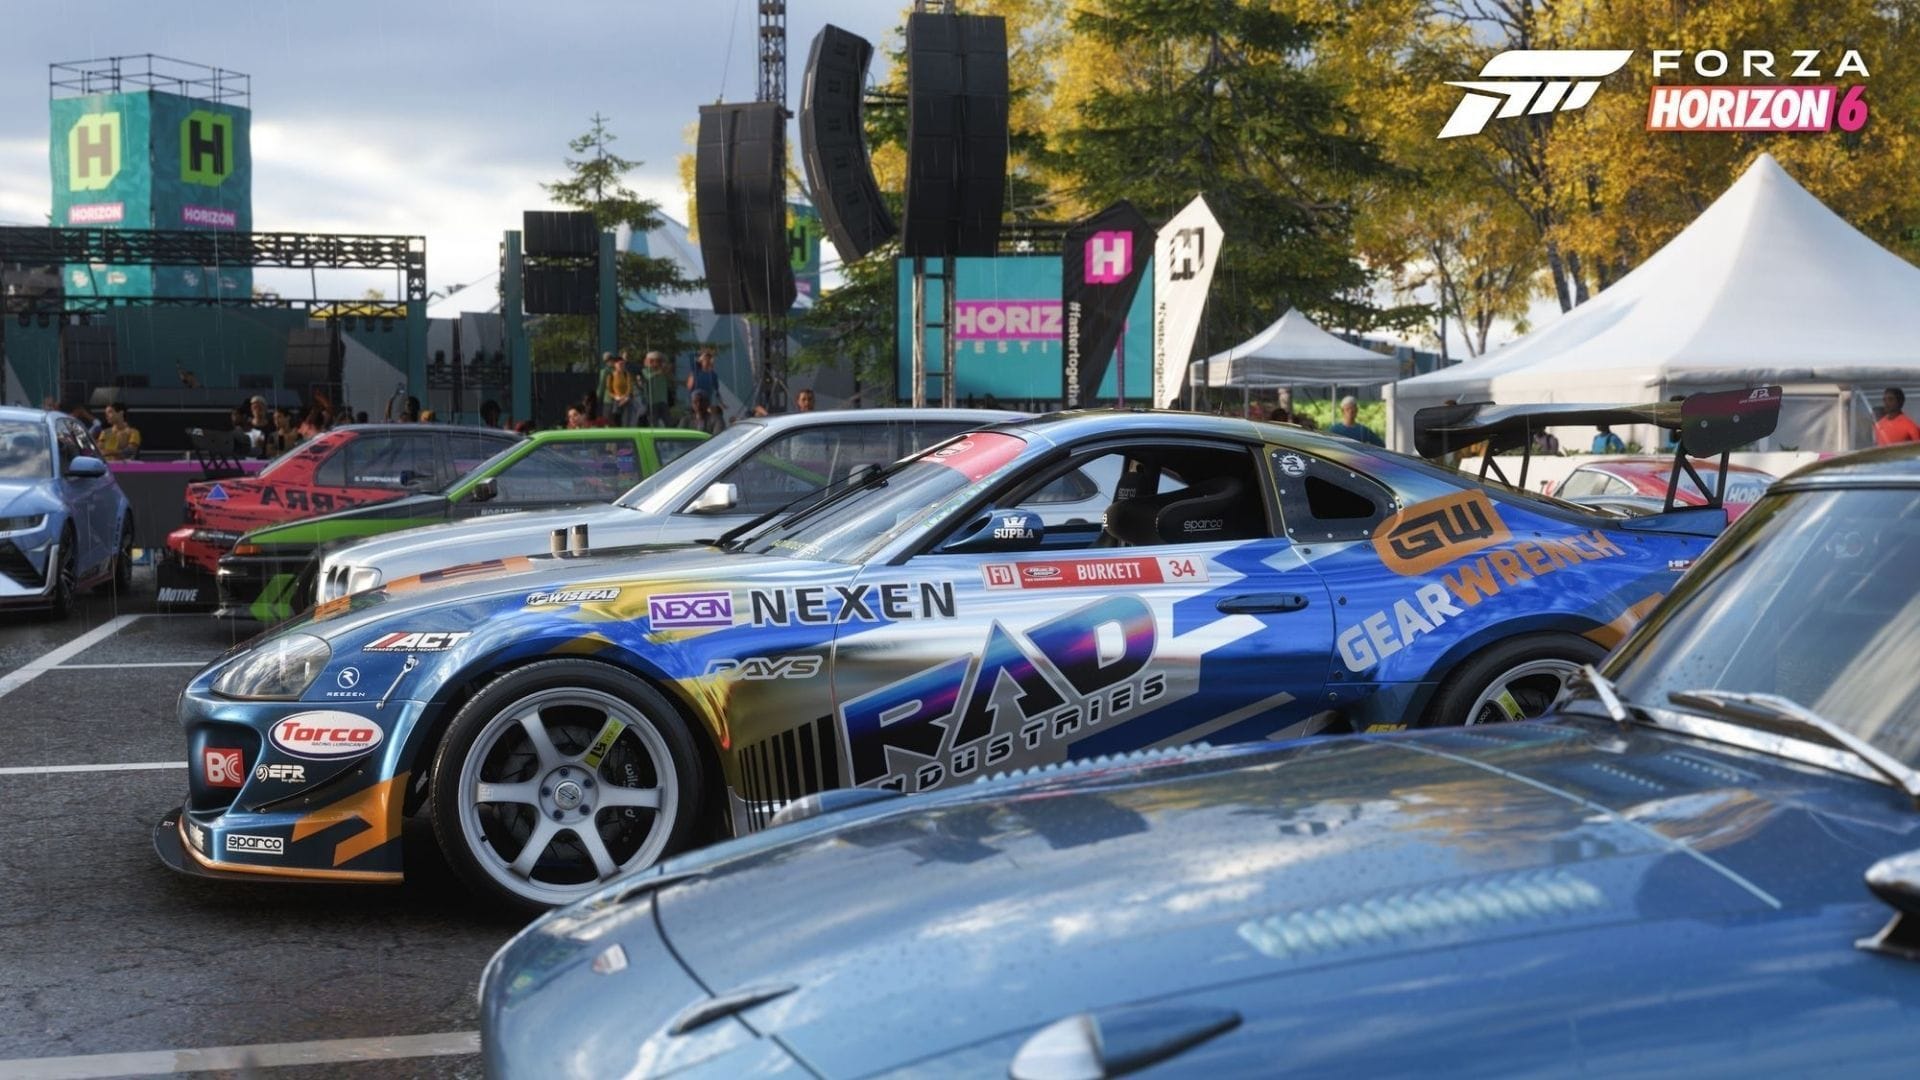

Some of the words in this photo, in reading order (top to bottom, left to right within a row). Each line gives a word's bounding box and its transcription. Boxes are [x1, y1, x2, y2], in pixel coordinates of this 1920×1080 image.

[78, 124, 112, 178] H
[190, 119, 224, 175] H
[70, 205, 121, 223] HORIZON
[184, 206, 234, 226] HORIZON
[1092, 237, 1125, 276] H
[994, 529, 1034, 540] SUPRA
[1184, 519, 1223, 532] sparco
[1388, 500, 1494, 560] GW
[991, 566, 1012, 583] FD
[1077, 562, 1141, 581] BURKETT
[1169, 560, 1196, 578] 34
[158, 587, 199, 601] MOTIVE
[549, 589, 620, 603] WISEFAB
[753, 583, 955, 623] NEXEN
[651, 599, 732, 620] NEXEN
[706, 655, 822, 680] RAYS
[841, 594, 1158, 787] RAD
[282, 722, 374, 742] Torco
[269, 764, 305, 779] EFR
[227, 835, 283, 850] sparco
